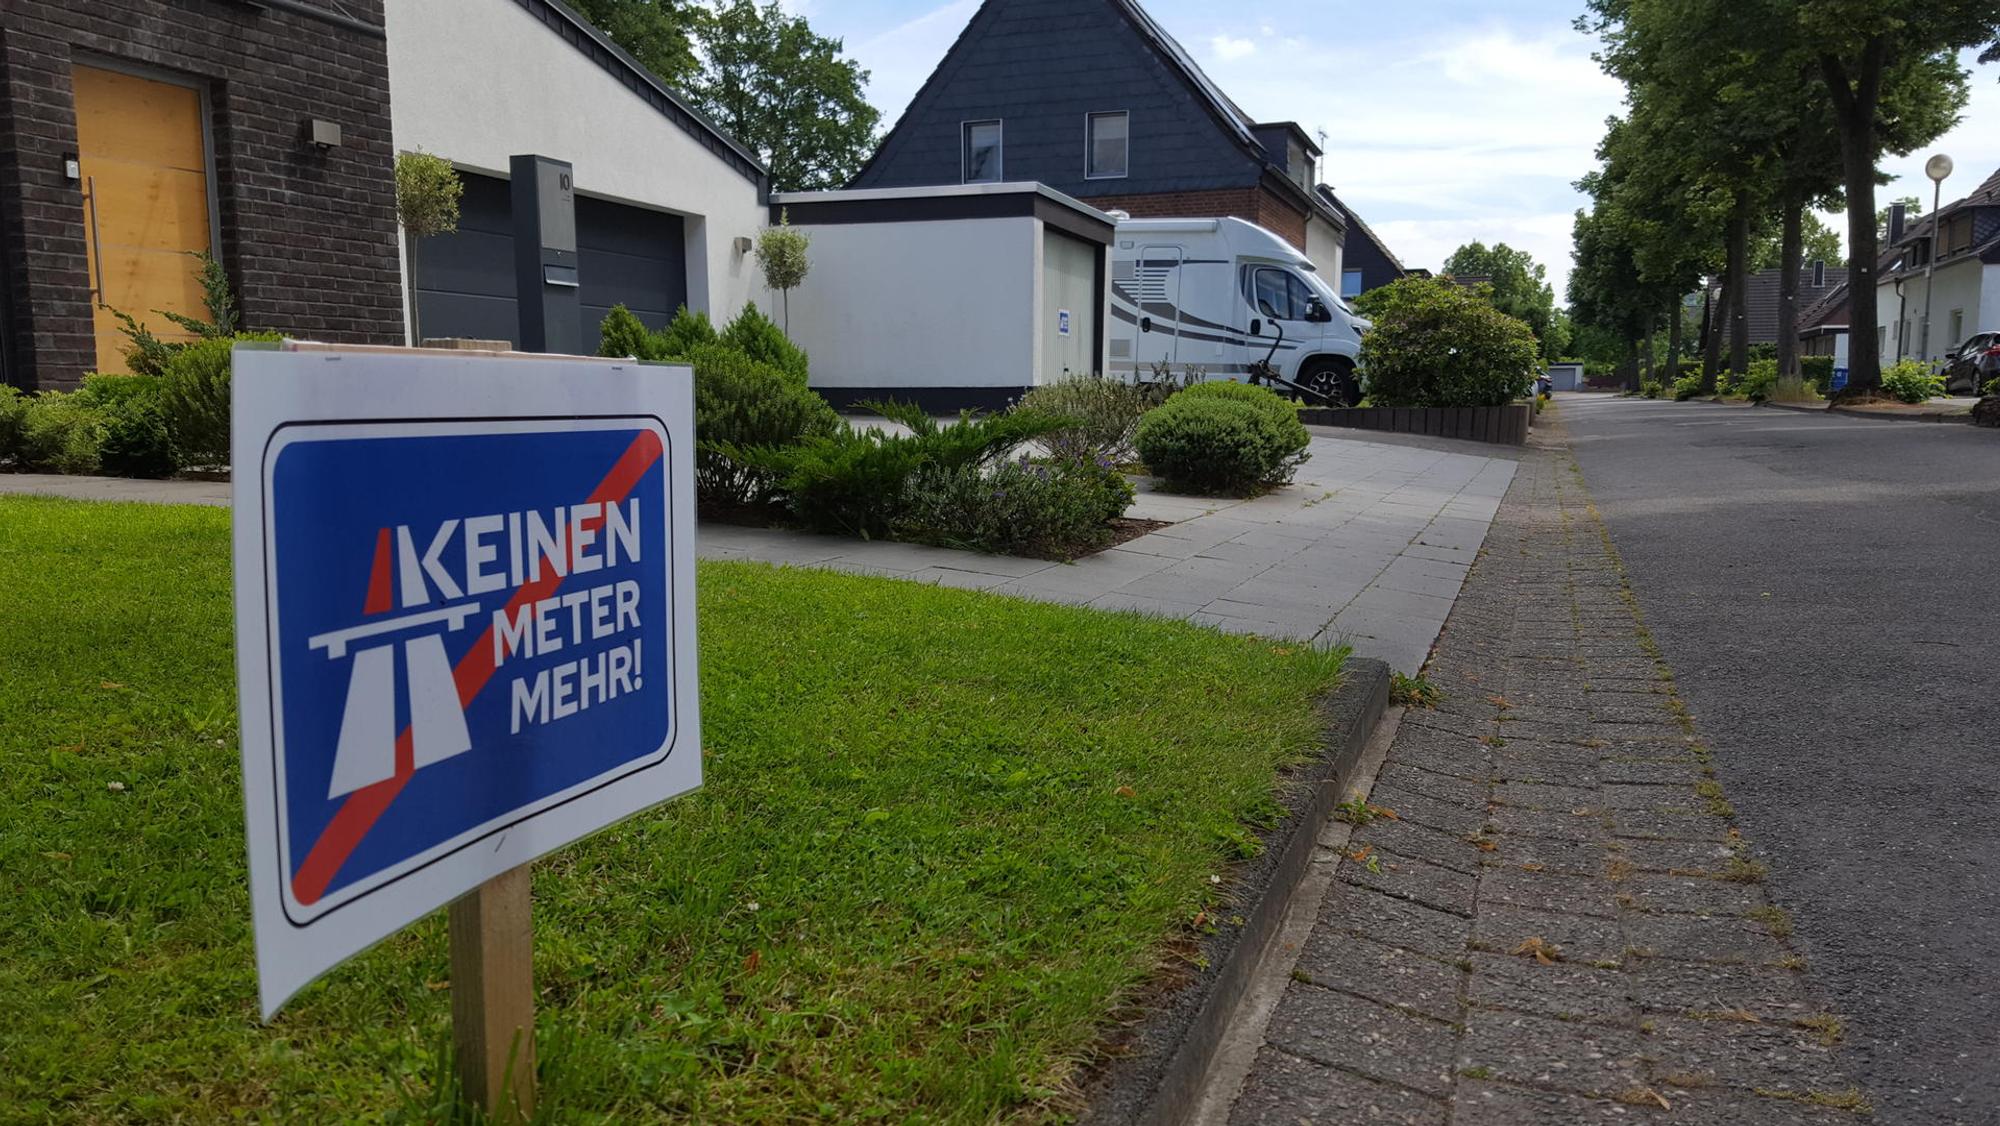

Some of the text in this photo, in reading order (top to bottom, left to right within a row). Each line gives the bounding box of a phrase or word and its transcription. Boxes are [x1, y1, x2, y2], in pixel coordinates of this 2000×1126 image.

[559, 173, 570, 191] 10
[397, 498, 641, 608] KEINEN
[493, 580, 641, 668] METER
[511, 638, 643, 735] MEHR!
